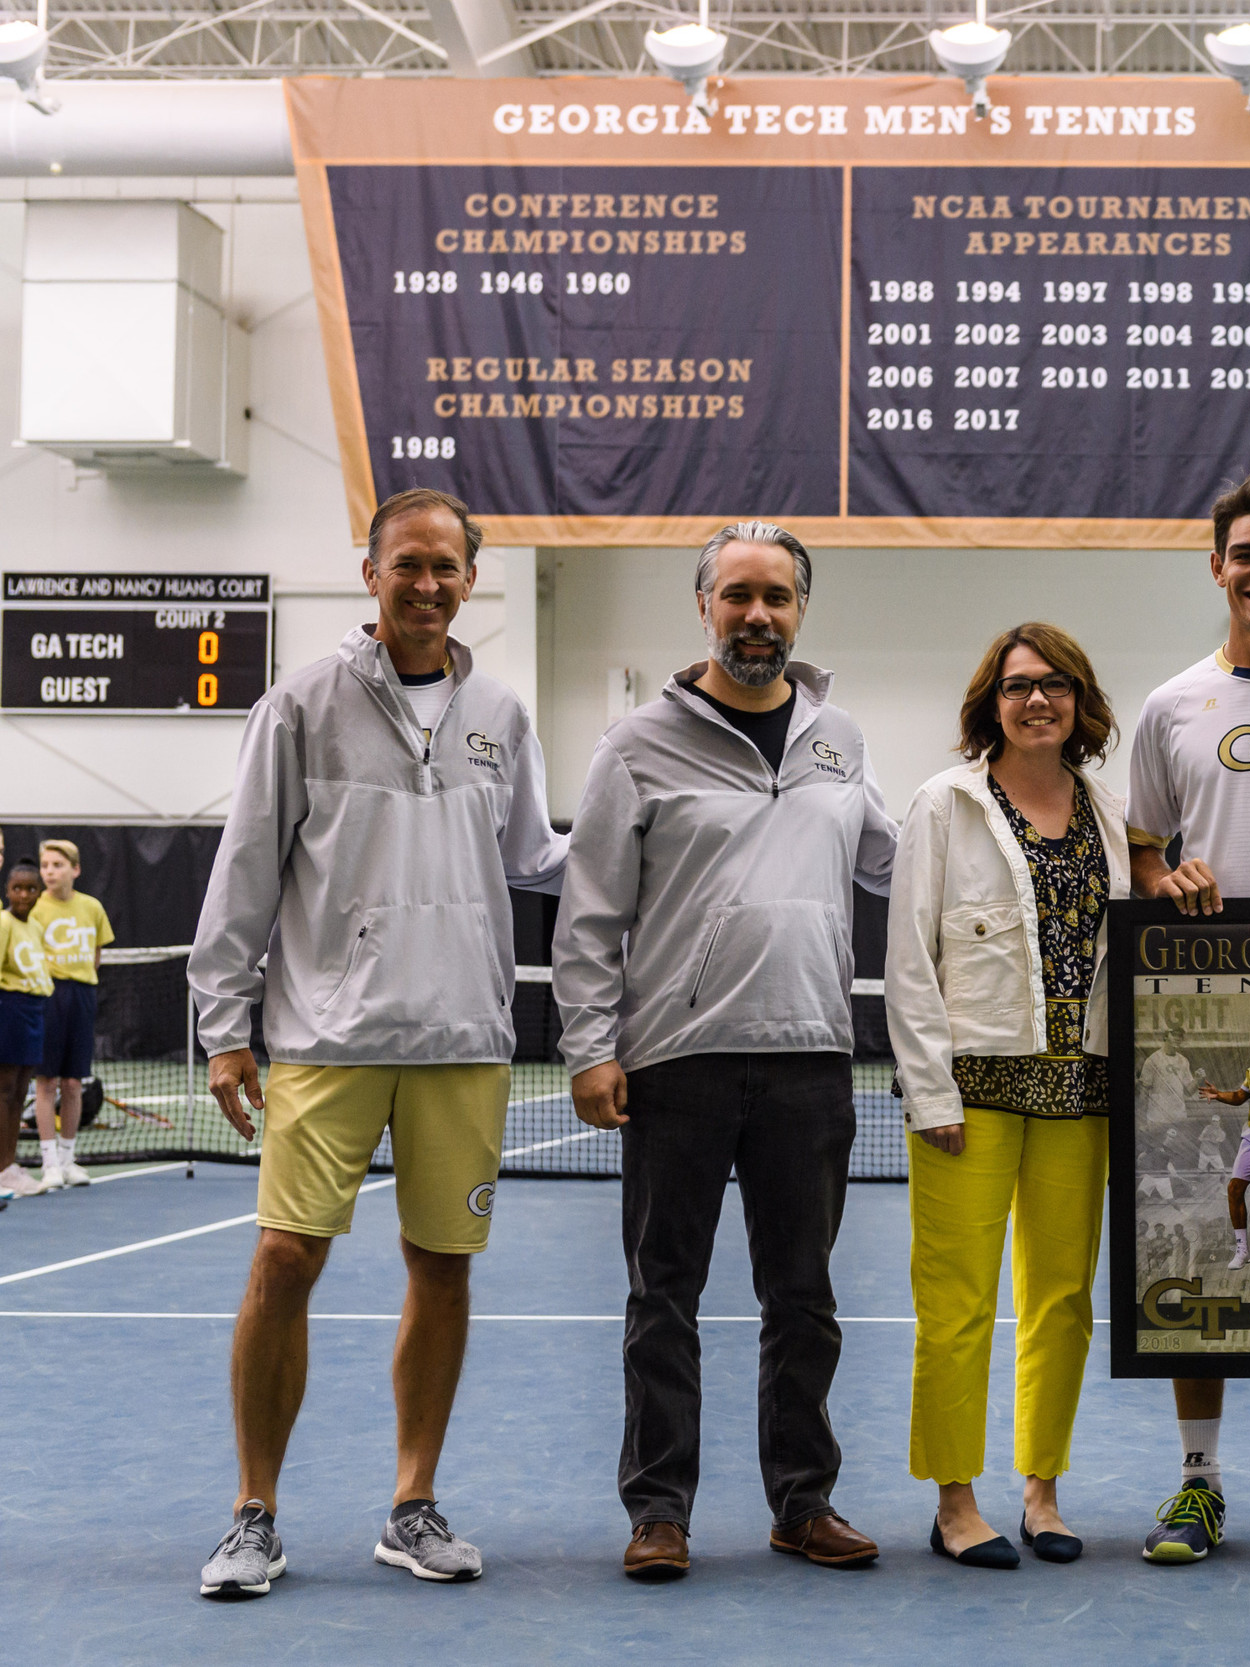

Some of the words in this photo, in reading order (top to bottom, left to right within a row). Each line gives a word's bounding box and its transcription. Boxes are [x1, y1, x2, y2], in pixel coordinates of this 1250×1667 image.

[493, 104, 712, 134] GEORGIA
[725, 104, 849, 135] TECH
[864, 105, 1012, 135] MENS
[1025, 105, 1197, 136] TENNIS
[465, 193, 719, 218] CONFERENCE
[912, 195, 1014, 219] NCAA
[435, 229, 747, 254] CHAMPIONSHIPS
[964, 231, 1232, 256] APPEARANCES
[394, 270, 458, 294] 1938
[480, 271, 544, 295] 1946
[566, 272, 631, 295] 1960
[869, 280, 934, 303] 1988
[956, 280, 1021, 303] 1994
[1043, 281, 1108, 303] 1997
[1128, 281, 1193, 304] 1998
[868, 323, 932, 345] 2001
[954, 323, 1020, 346] 2002
[1041, 323, 1108, 346] 2003
[1126, 324, 1192, 346] 2004
[426, 357, 598, 383] REGULAR
[611, 358, 754, 383] SEASON
[867, 365, 933, 388] 2006
[954, 366, 1020, 388] 2007
[1041, 366, 1108, 389] 2010
[1126, 367, 1191, 389] 2011
[434, 393, 745, 419] CHAMPIONSHIPS
[867, 407, 933, 431] 2016
[954, 408, 1020, 431] 2017
[392, 436, 456, 460] 1988
[7, 578, 78, 597] LAWRENCE
[81, 578, 112, 597] AND
[113, 578, 162, 597] NANCY
[164, 578, 215, 598] HUANG
[218, 579, 263, 598] COURT
[155, 610, 211, 629] COURT
[214, 610, 226, 629] 2
[31, 633, 63, 660] GA
[65, 633, 124, 660] TECH
[198, 631, 219, 664] 0
[40, 676, 111, 703] GUEST
[197, 673, 218, 706] 0
[465, 731, 499, 760] GT
[811, 740, 843, 767] GT
[468, 757, 499, 771] TENNIS
[814, 762, 847, 778] TENNIS
[44, 916, 97, 953] GT
[1140, 1335, 1182, 1351] 2018
